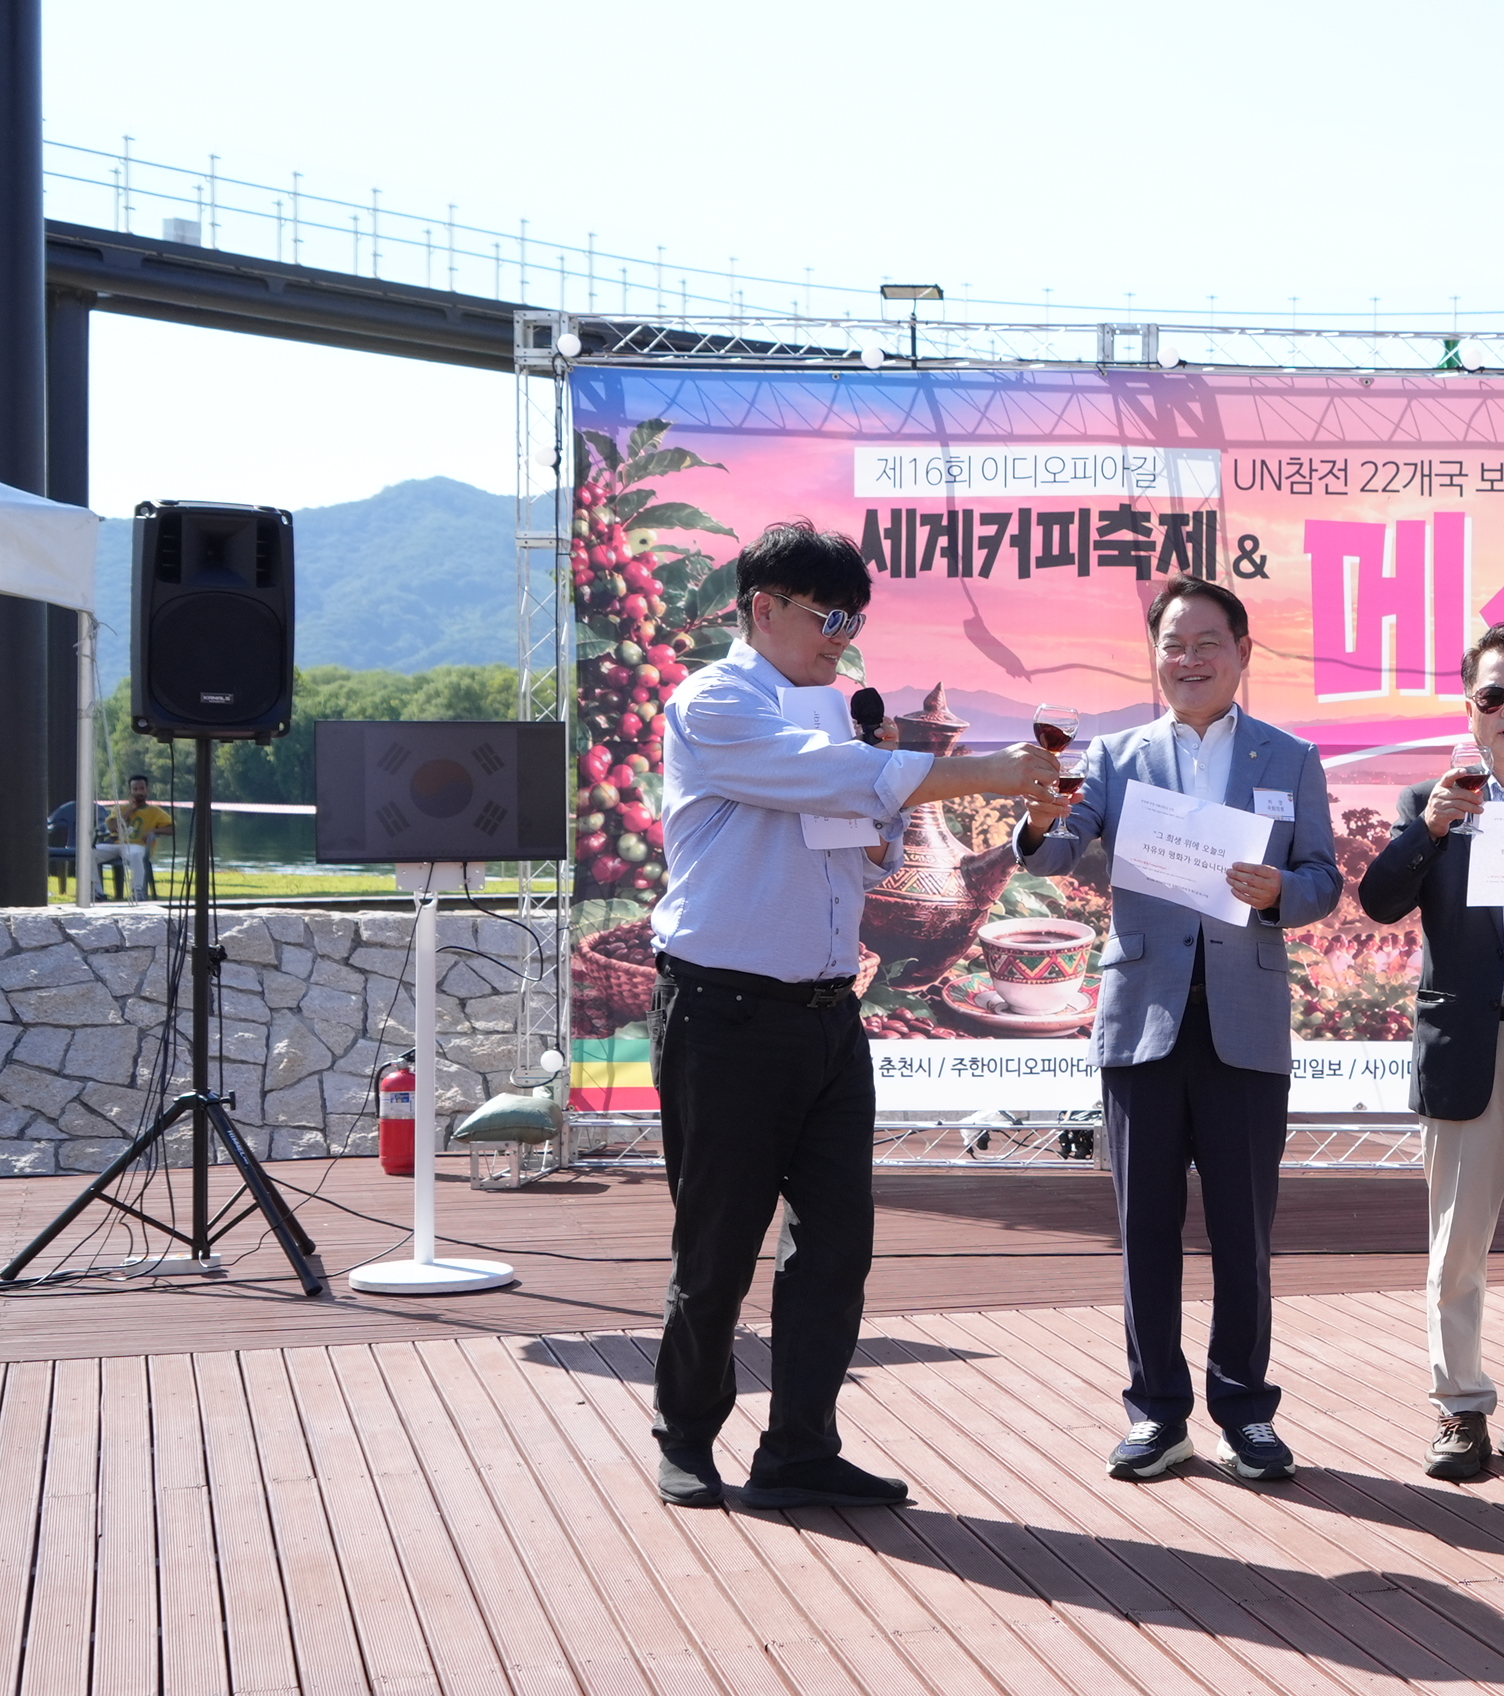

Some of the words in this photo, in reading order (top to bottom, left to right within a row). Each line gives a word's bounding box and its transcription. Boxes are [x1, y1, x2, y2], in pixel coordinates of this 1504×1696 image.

[875, 455, 973, 489] 제16회
[981, 455, 1157, 489] 이디오피아길
[1233, 457, 1349, 496] UN참전
[1359, 459, 1469, 498] 22개국
[861, 503, 1218, 581] 세계커피축제
[1232, 534, 1271, 580] &
[1142, 843, 1166, 857] 자유와
[1168, 849, 1191, 864] 평화가
[1202, 843, 1227, 858] 오늘의
[878, 1056, 931, 1078] 춘천시
[950, 1056, 1100, 1078] 주한이디오피아대
[1361, 1058, 1412, 1080] 사)이
